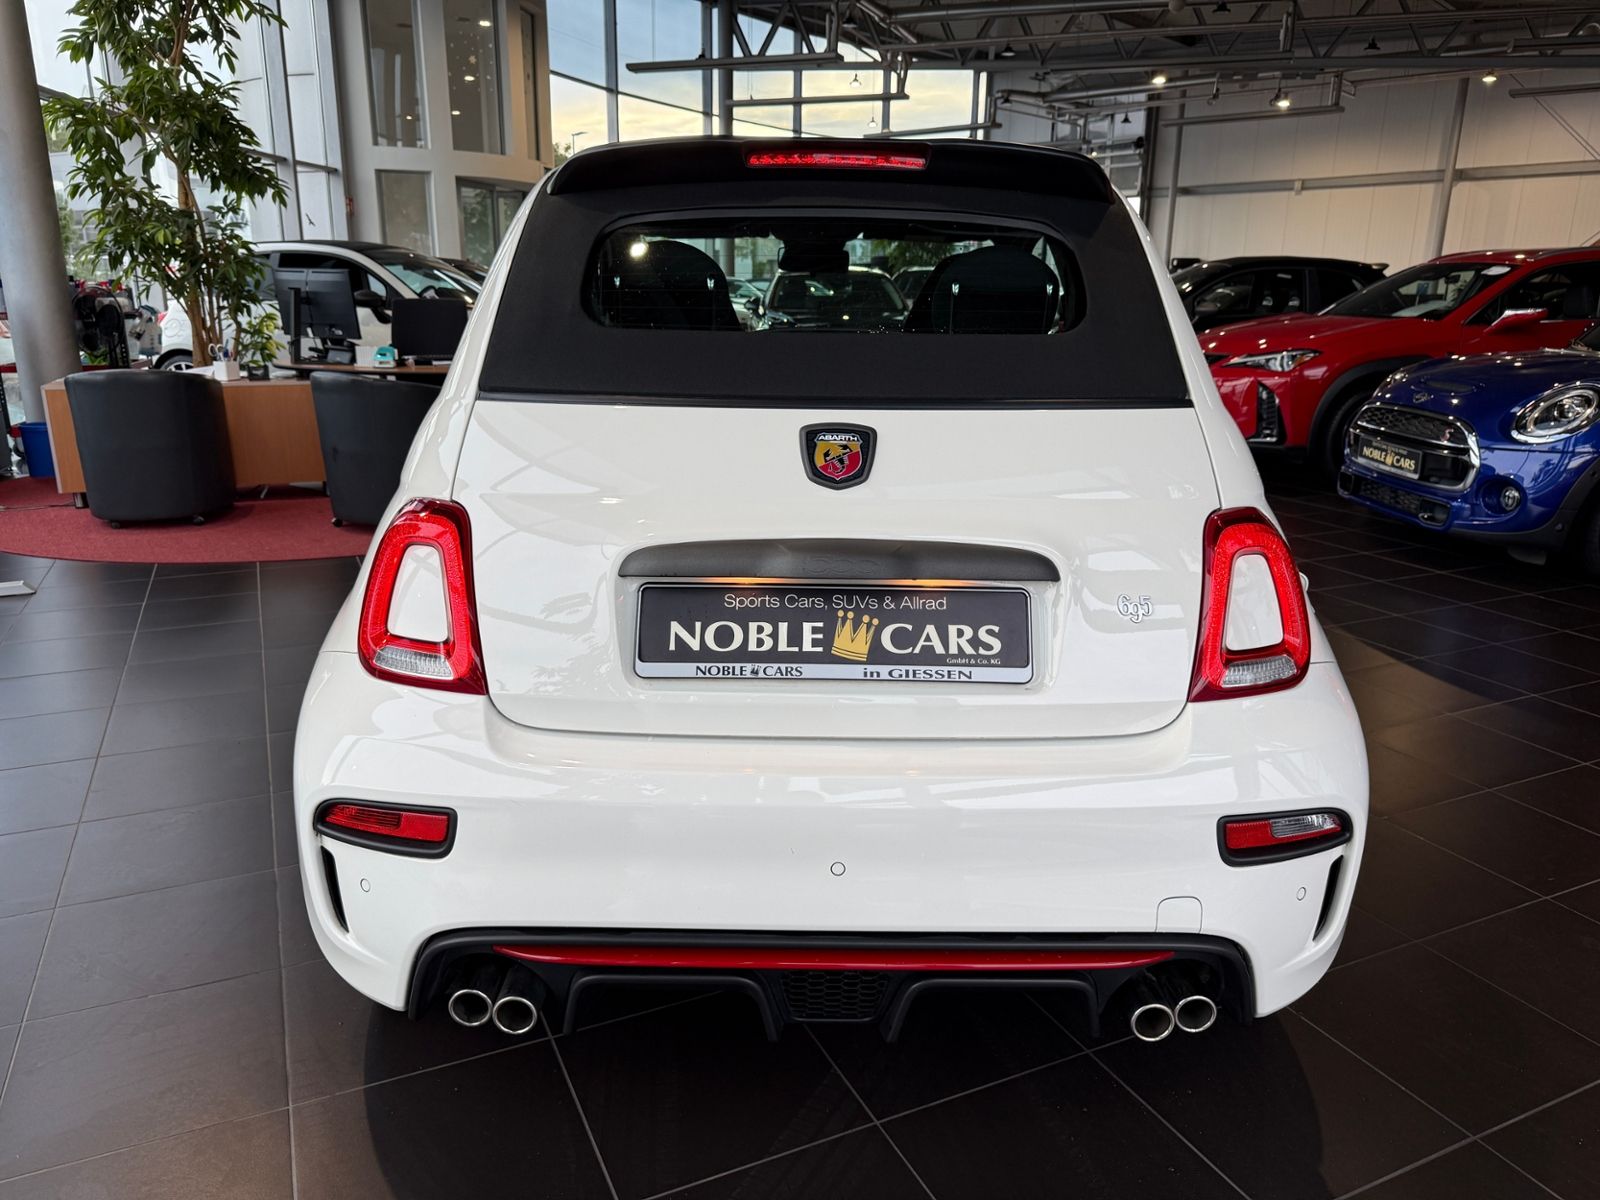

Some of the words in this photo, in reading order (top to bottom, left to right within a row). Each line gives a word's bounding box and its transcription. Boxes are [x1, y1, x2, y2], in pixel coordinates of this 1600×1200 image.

[1362, 446, 1387, 463] NOBLE
[1393, 455, 1416, 471] CARS
[724, 593, 780, 610] Sports
[784, 594, 828, 610] Cars,
[831, 595, 878, 609] SUVs
[884, 596, 896, 609] &
[899, 596, 947, 610] Allrad
[1117, 594, 1152, 624] 695
[669, 620, 824, 652] NOBLE
[880, 623, 1002, 656] CARS
[695, 665, 748, 676] NOBLE
[762, 666, 803, 677] CARS
[863, 668, 881, 679] in
[888, 669, 973, 680] GIESSEN
